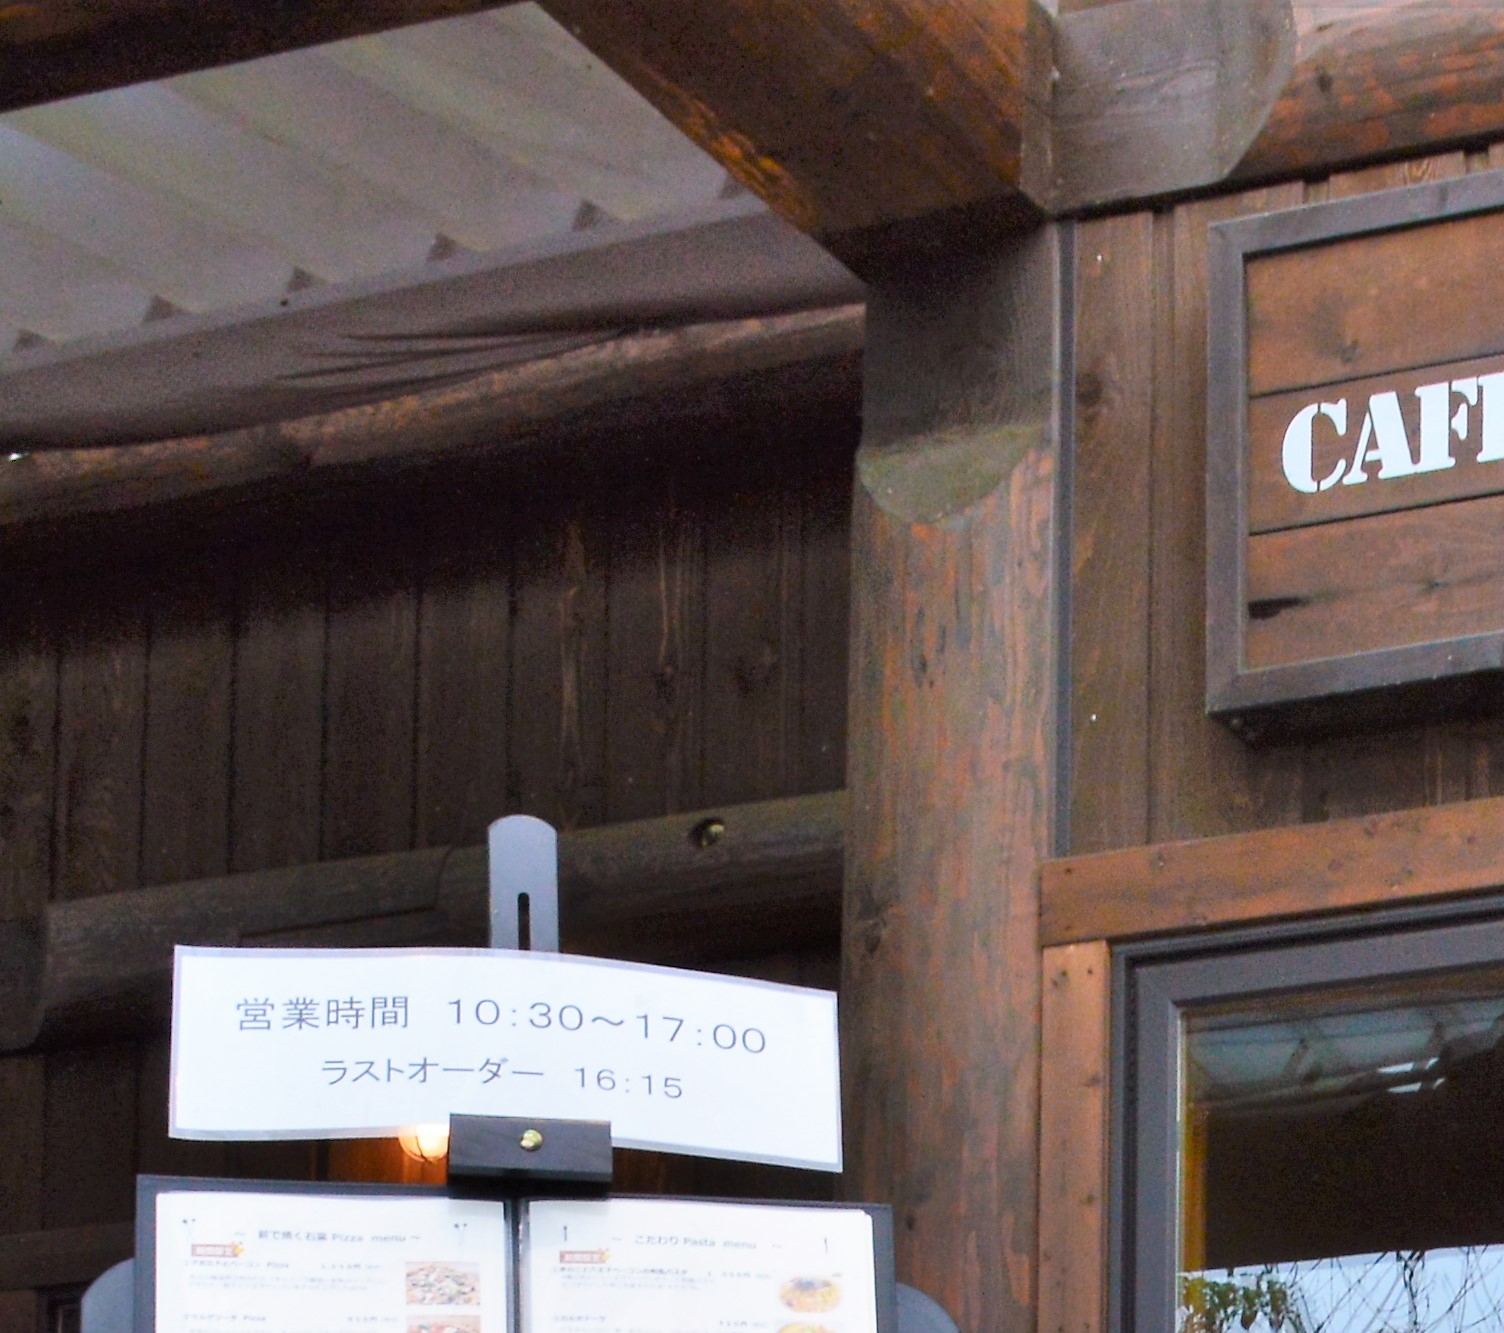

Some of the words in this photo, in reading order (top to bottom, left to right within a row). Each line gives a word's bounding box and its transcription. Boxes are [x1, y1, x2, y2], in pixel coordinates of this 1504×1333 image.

[236, 997, 410, 1032] 営業時間
[321, 1056, 544, 1085] ラストオーダー
[574, 1067, 683, 1099] 16:15
